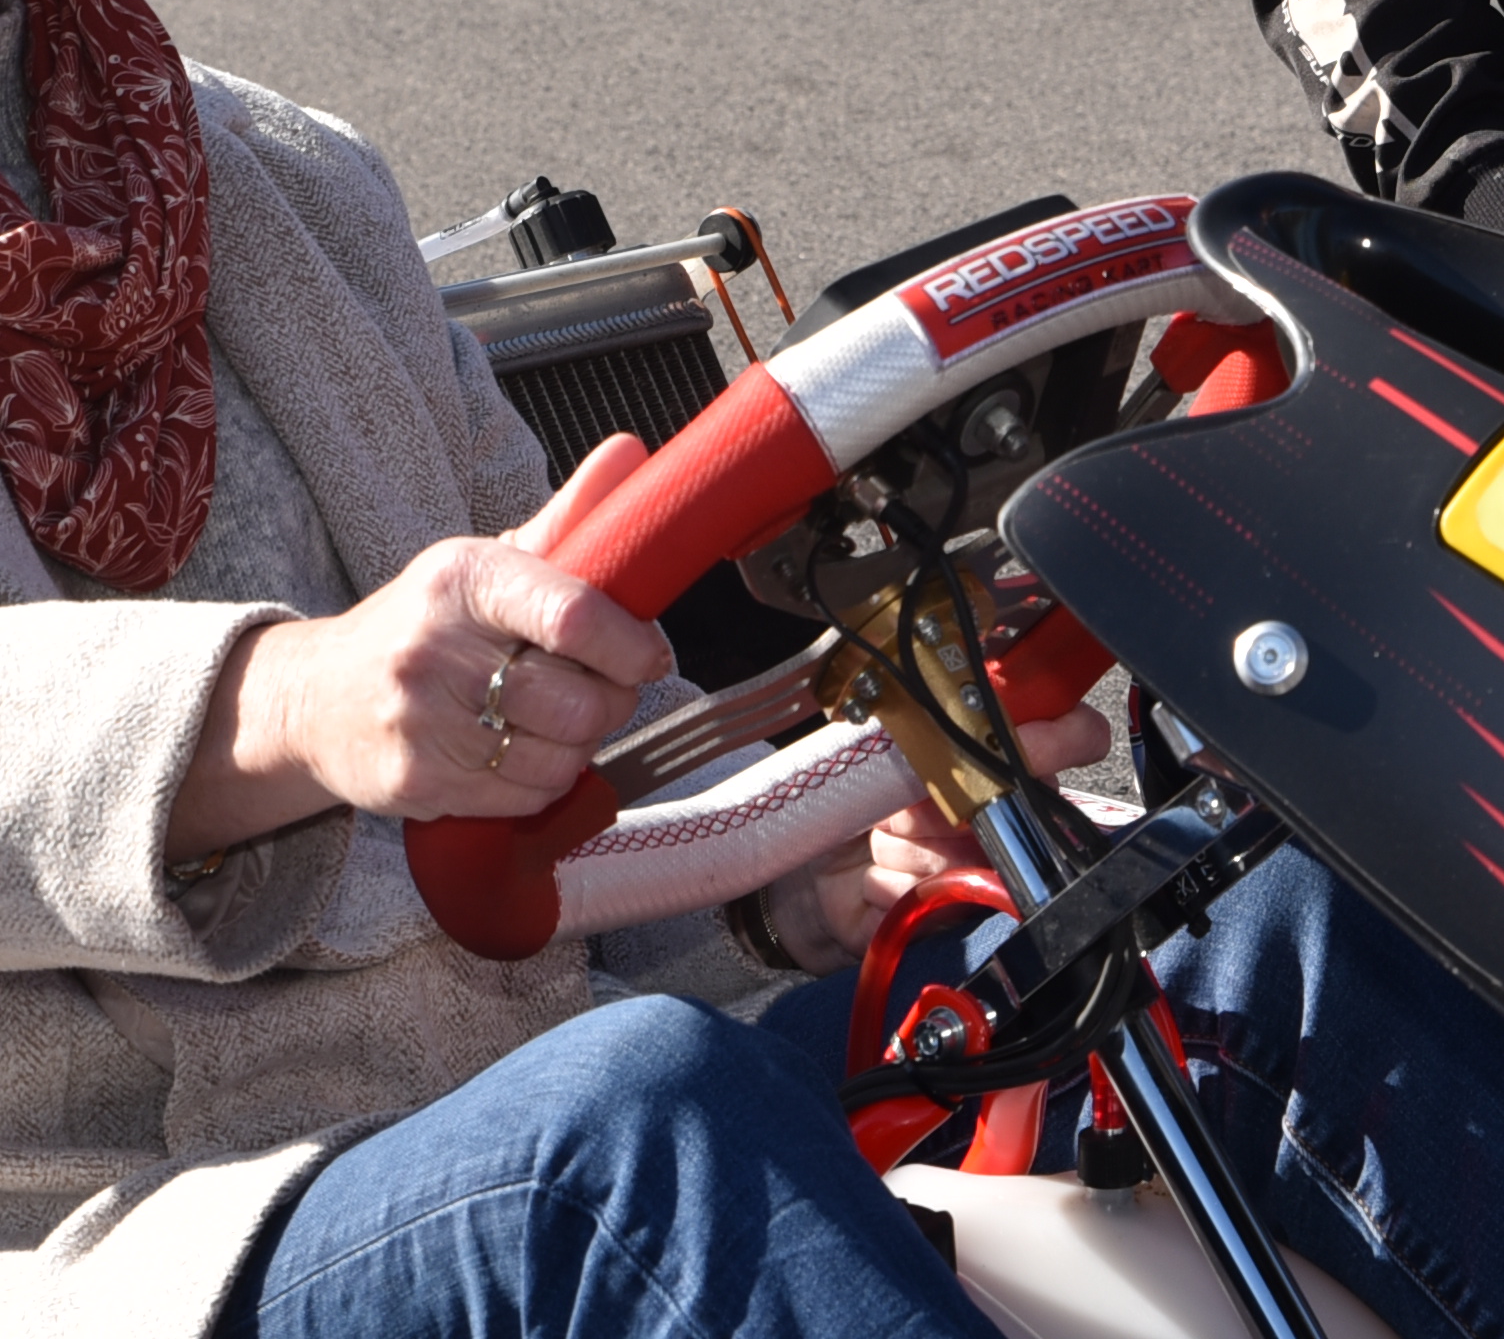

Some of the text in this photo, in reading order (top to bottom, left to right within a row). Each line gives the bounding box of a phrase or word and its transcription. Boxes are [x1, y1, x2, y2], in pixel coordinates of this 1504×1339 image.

[922, 202, 1176, 312] REDSPEED
[990, 253, 1164, 331] RACING KART
